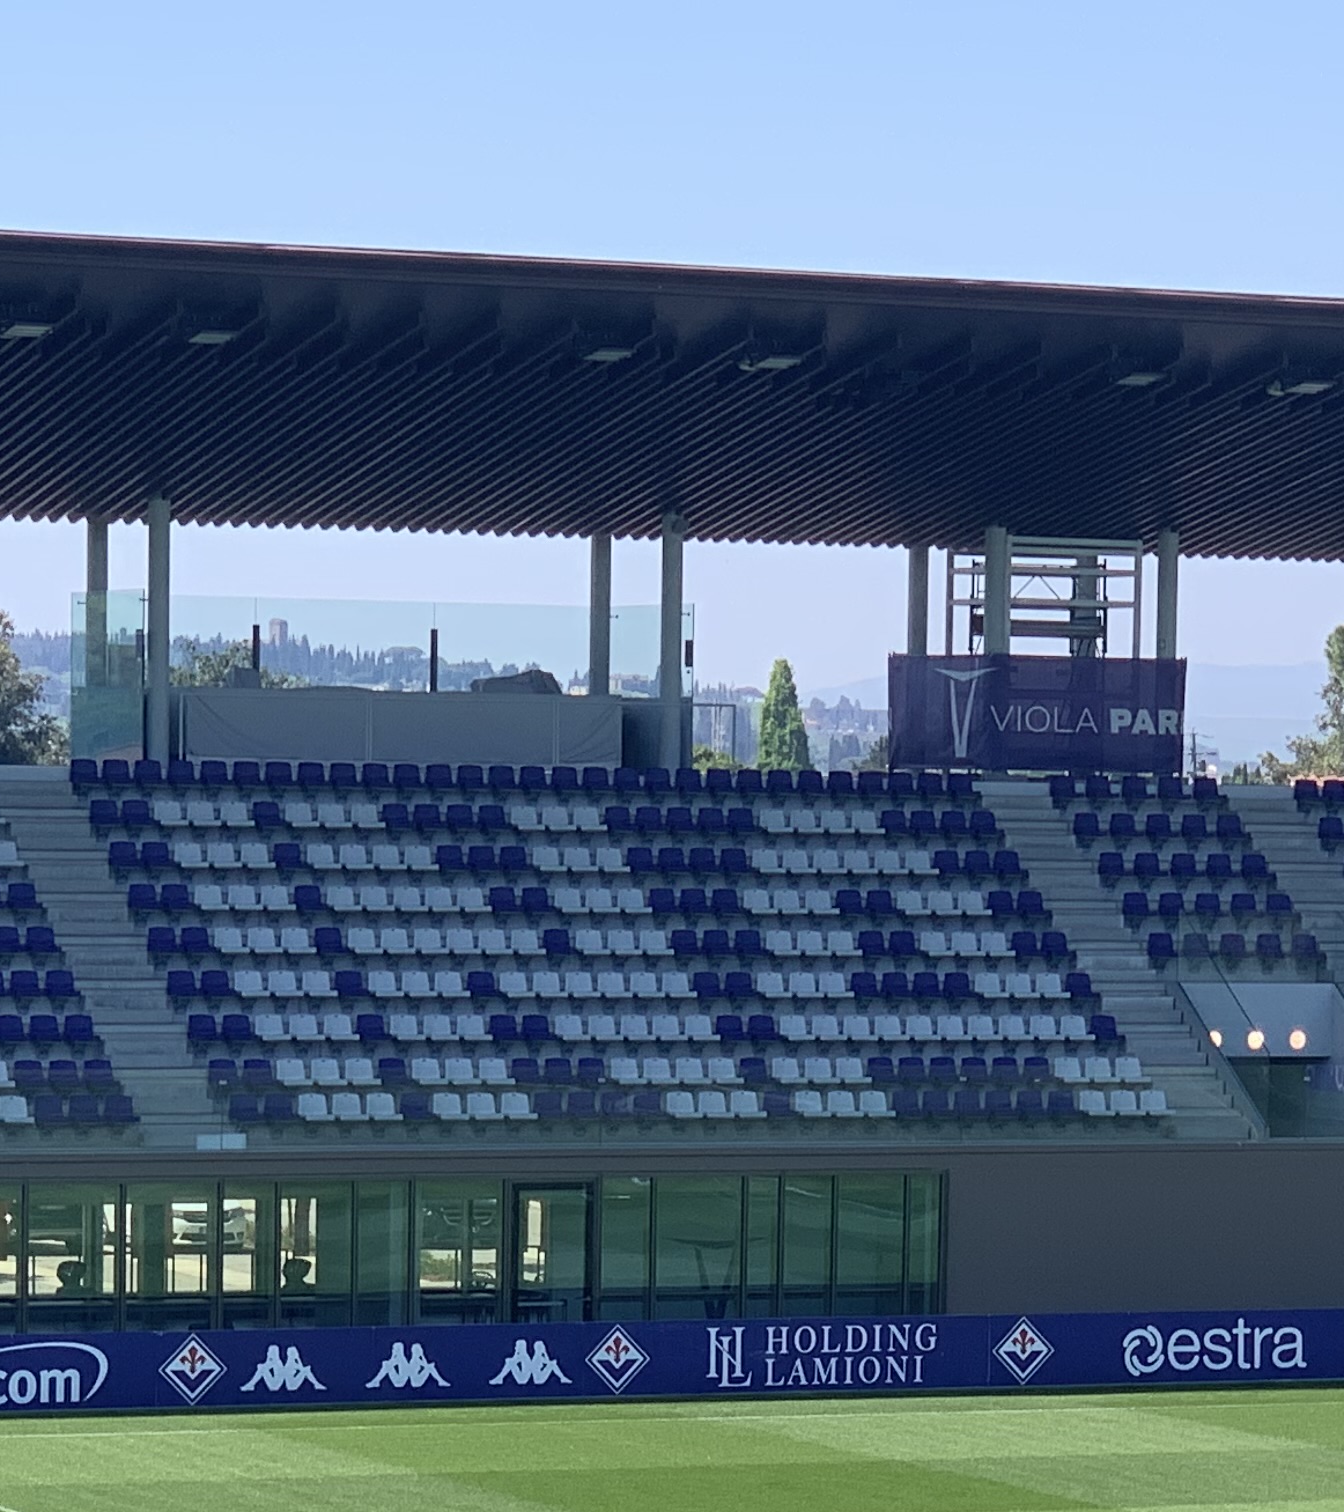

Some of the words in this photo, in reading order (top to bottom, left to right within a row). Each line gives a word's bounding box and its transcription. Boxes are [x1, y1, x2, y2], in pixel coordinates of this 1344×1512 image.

[990, 705, 1098, 734] VIOLA
[1110, 707, 1183, 736] PAR
[765, 1323, 938, 1354] HOLDING
[763, 1355, 925, 1387] LAMIONI
